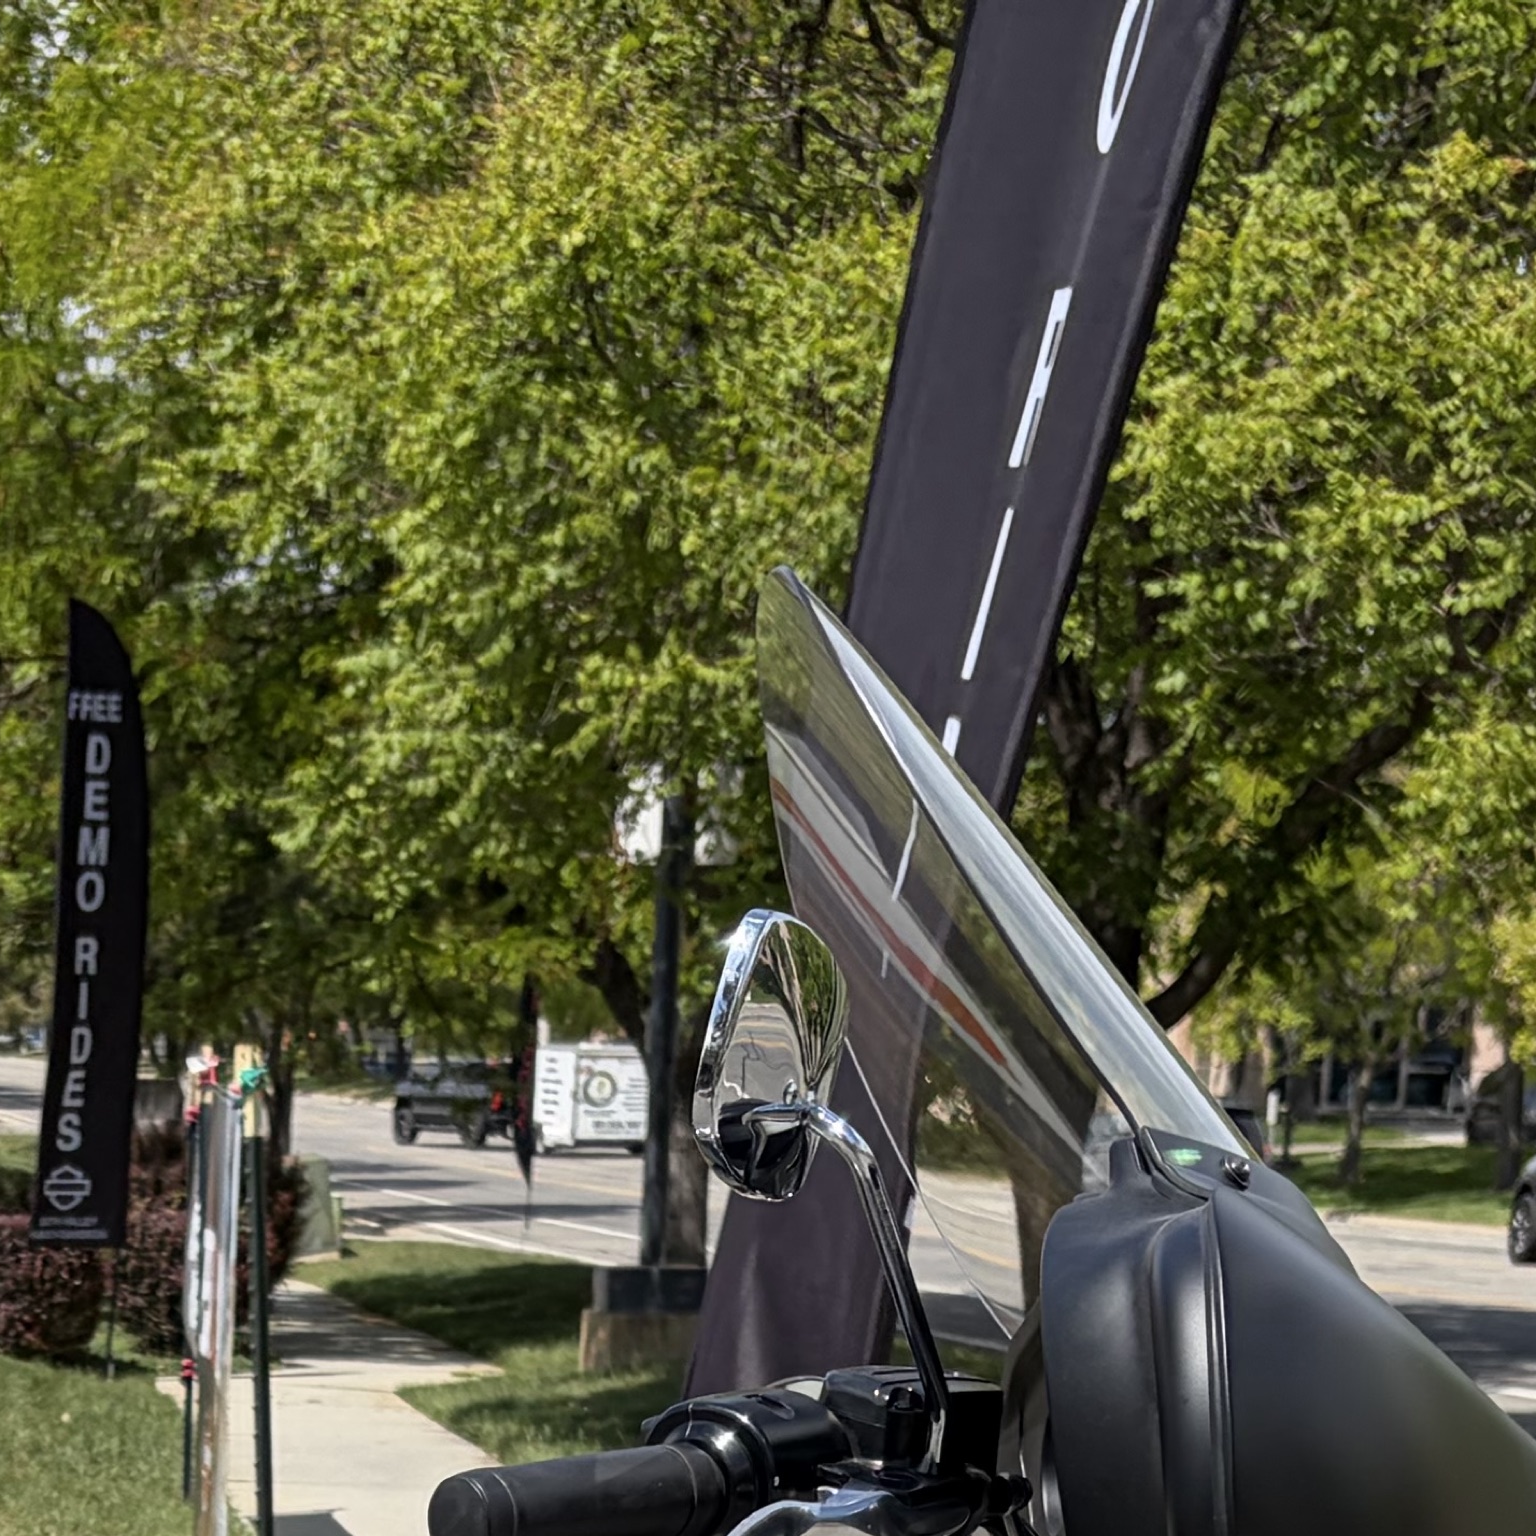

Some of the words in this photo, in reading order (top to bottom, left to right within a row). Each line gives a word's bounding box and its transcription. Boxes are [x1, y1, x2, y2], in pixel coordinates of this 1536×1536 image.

[67, 691, 123, 723] FREE
[75, 732, 112, 913] DEMO
[54, 936, 98, 1153] RIDES
